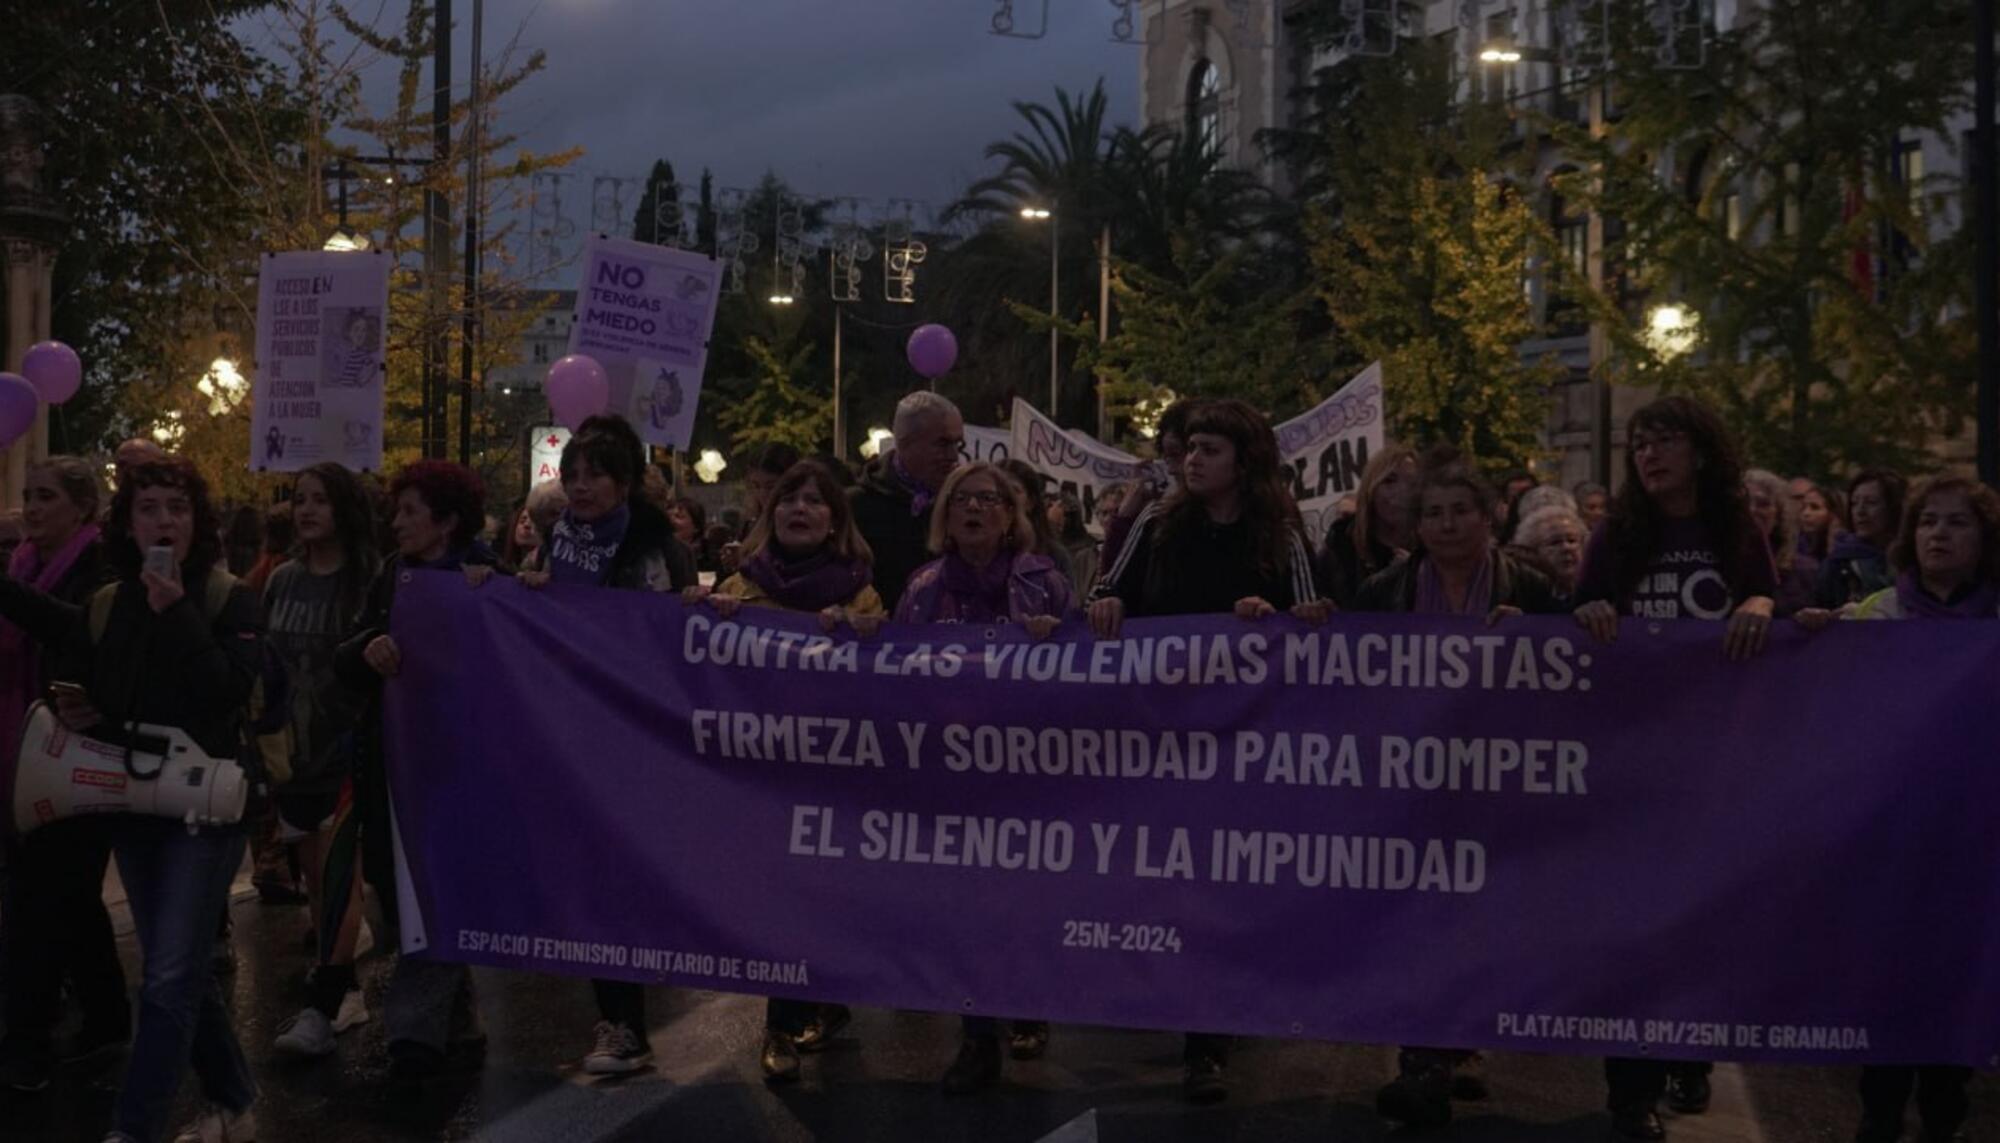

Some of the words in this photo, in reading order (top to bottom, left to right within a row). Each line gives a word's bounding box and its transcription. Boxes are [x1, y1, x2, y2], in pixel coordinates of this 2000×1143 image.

[274, 278, 311, 295] ACCESO
[312, 273, 334, 294] EN
[598, 260, 645, 290] NO
[293, 298, 300, 315] A
[301, 297, 319, 316] LOS
[590, 286, 661, 313] TENGAS
[272, 318, 320, 336] SERVICIOS
[587, 307, 656, 336] MIEDO
[268, 401, 276, 418] A
[277, 401, 289, 418] LA
[290, 401, 322, 419] MUJER
[1632, 598, 1678, 619] PASO
[683, 614, 858, 673] CONTRA
[873, 641, 968, 678] LAS
[982, 633, 1268, 684] VIOLENCIAS
[1284, 633, 1593, 692] MACHISTAS:
[691, 709, 885, 768] FIRMEZA
[898, 721, 927, 769] Y
[942, 723, 1218, 781] SORORIDAD
[1233, 731, 1363, 788] PARA
[1379, 735, 1589, 795] ROMPER
[788, 805, 845, 858] EL
[860, 809, 1074, 873] SILENCIO
[1090, 821, 1121, 875] Y
[1134, 825, 1194, 880] LA
[1210, 828, 1486, 894] IMPUNIDAD
[1063, 920, 1182, 953] 25N-2024
[458, 929, 529, 957] ESPACIO
[533, 936, 627, 968] FEMINISMO
[631, 947, 714, 976] UNITARIO
[718, 957, 742, 980] DE
[746, 959, 809, 987] GRANÁ
[1497, 1012, 1638, 1043] PLATAFORMA
[1644, 1018, 1729, 1047] 8M/25N
[1735, 1024, 1763, 1048] DE
[1768, 1024, 1870, 1052] GRANADA
